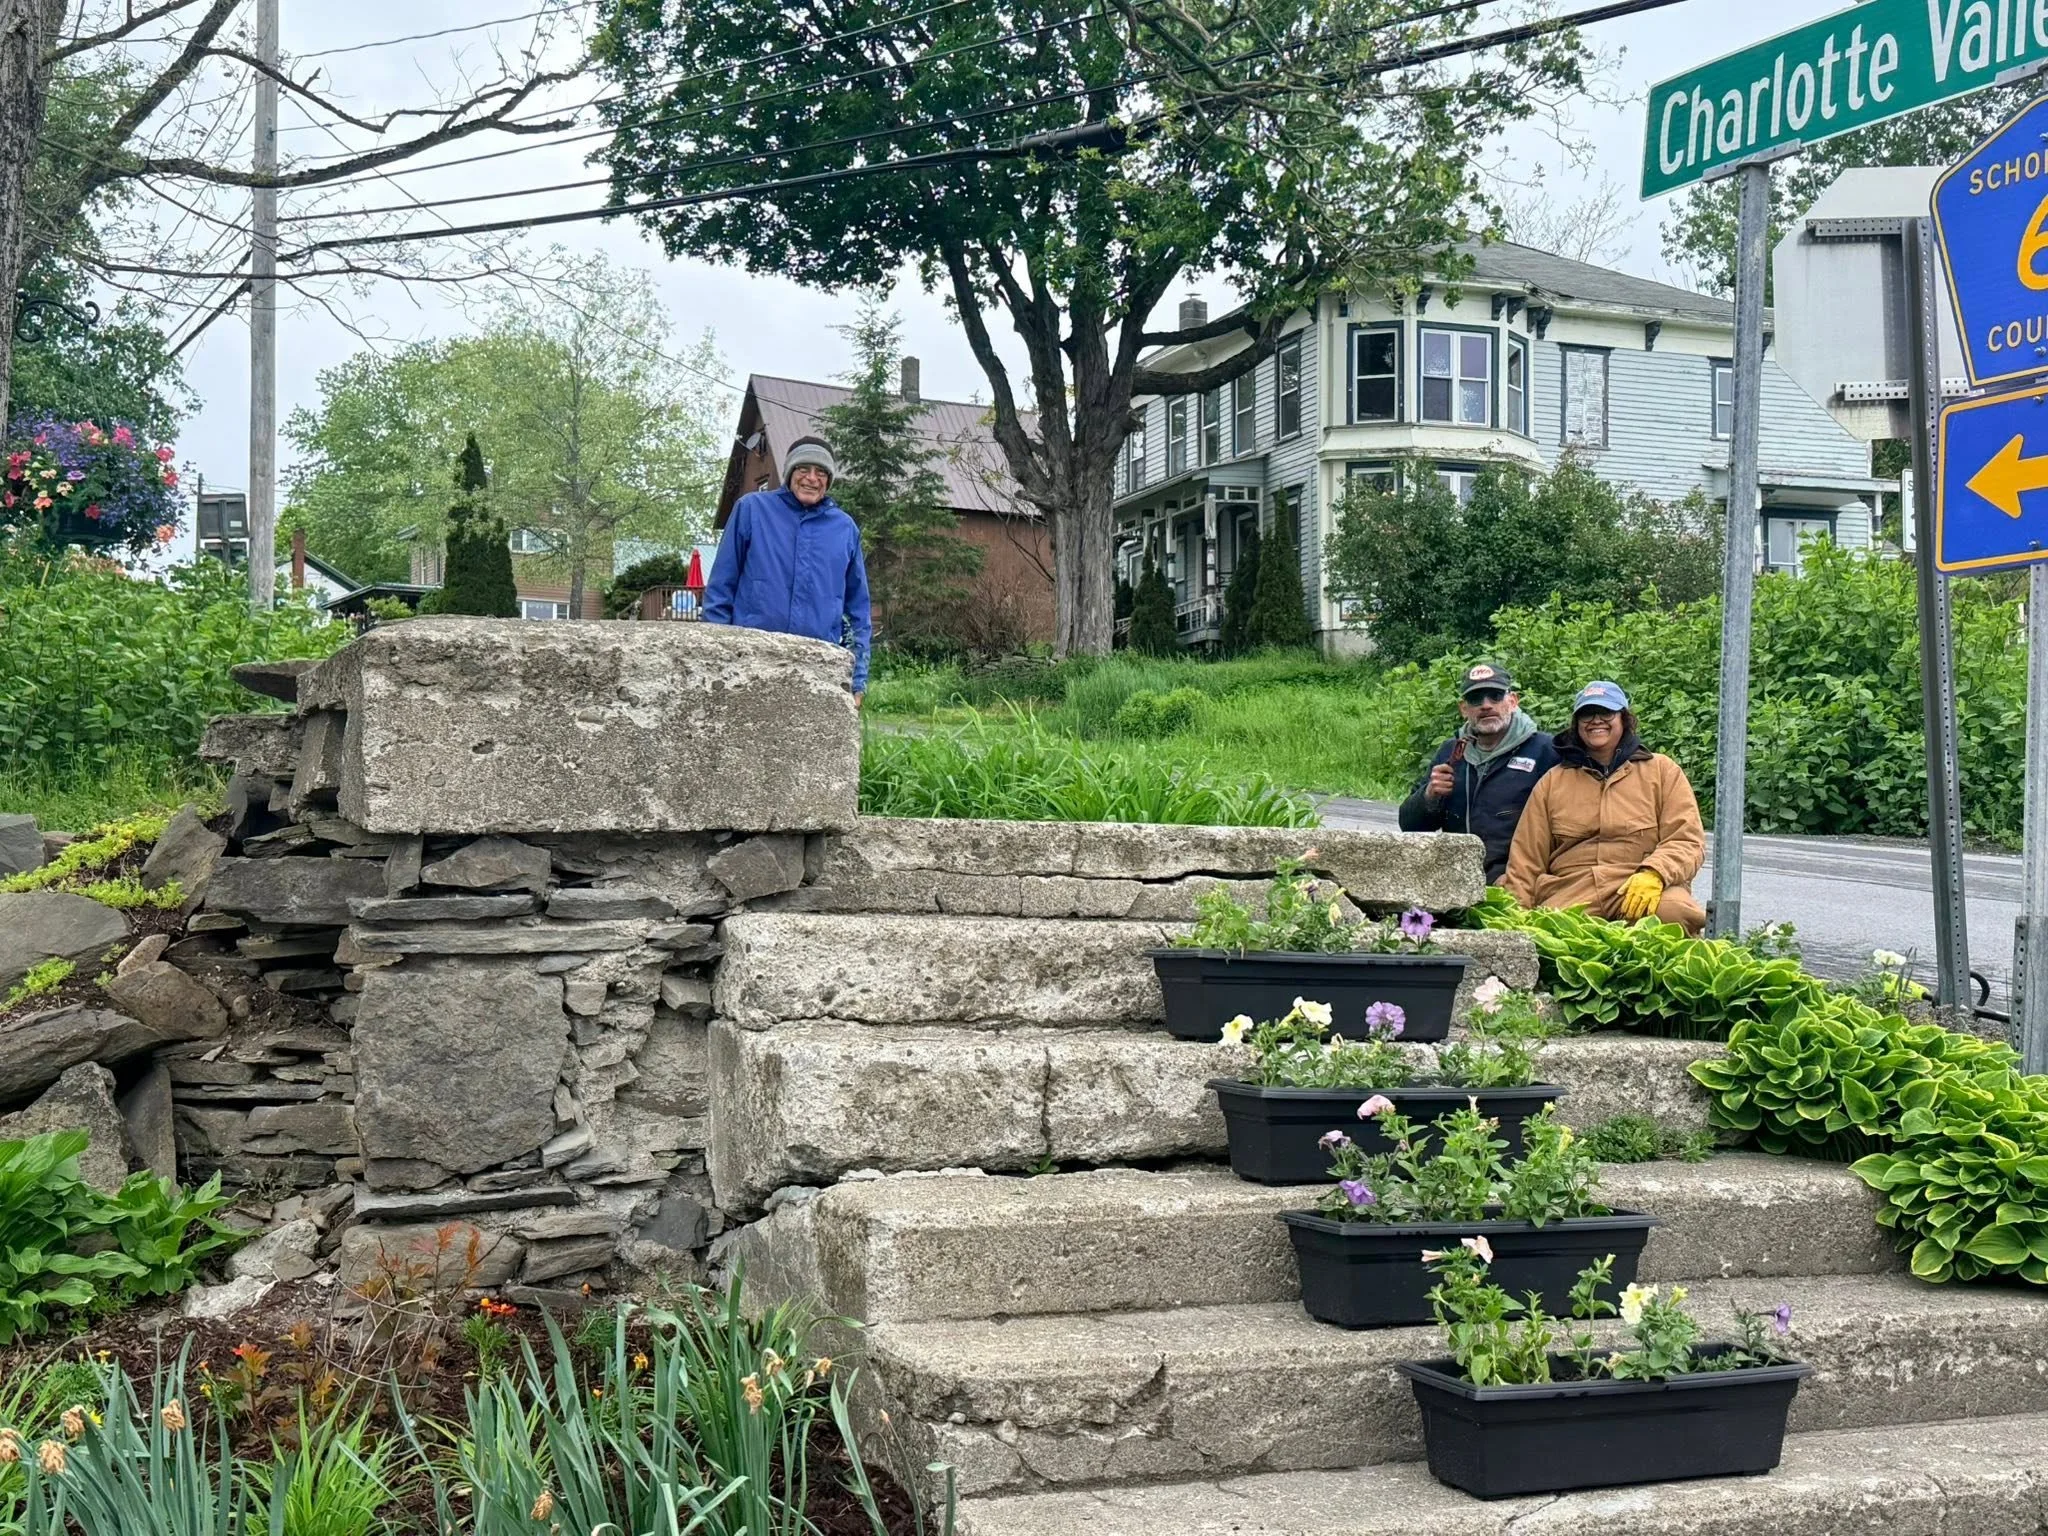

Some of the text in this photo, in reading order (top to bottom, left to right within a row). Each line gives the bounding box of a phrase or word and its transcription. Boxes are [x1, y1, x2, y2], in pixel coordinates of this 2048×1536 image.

[1659, 23, 1899, 175] Charlotte
[1969, 147, 2048, 194] SCHO
[1987, 313, 2048, 352] COU
